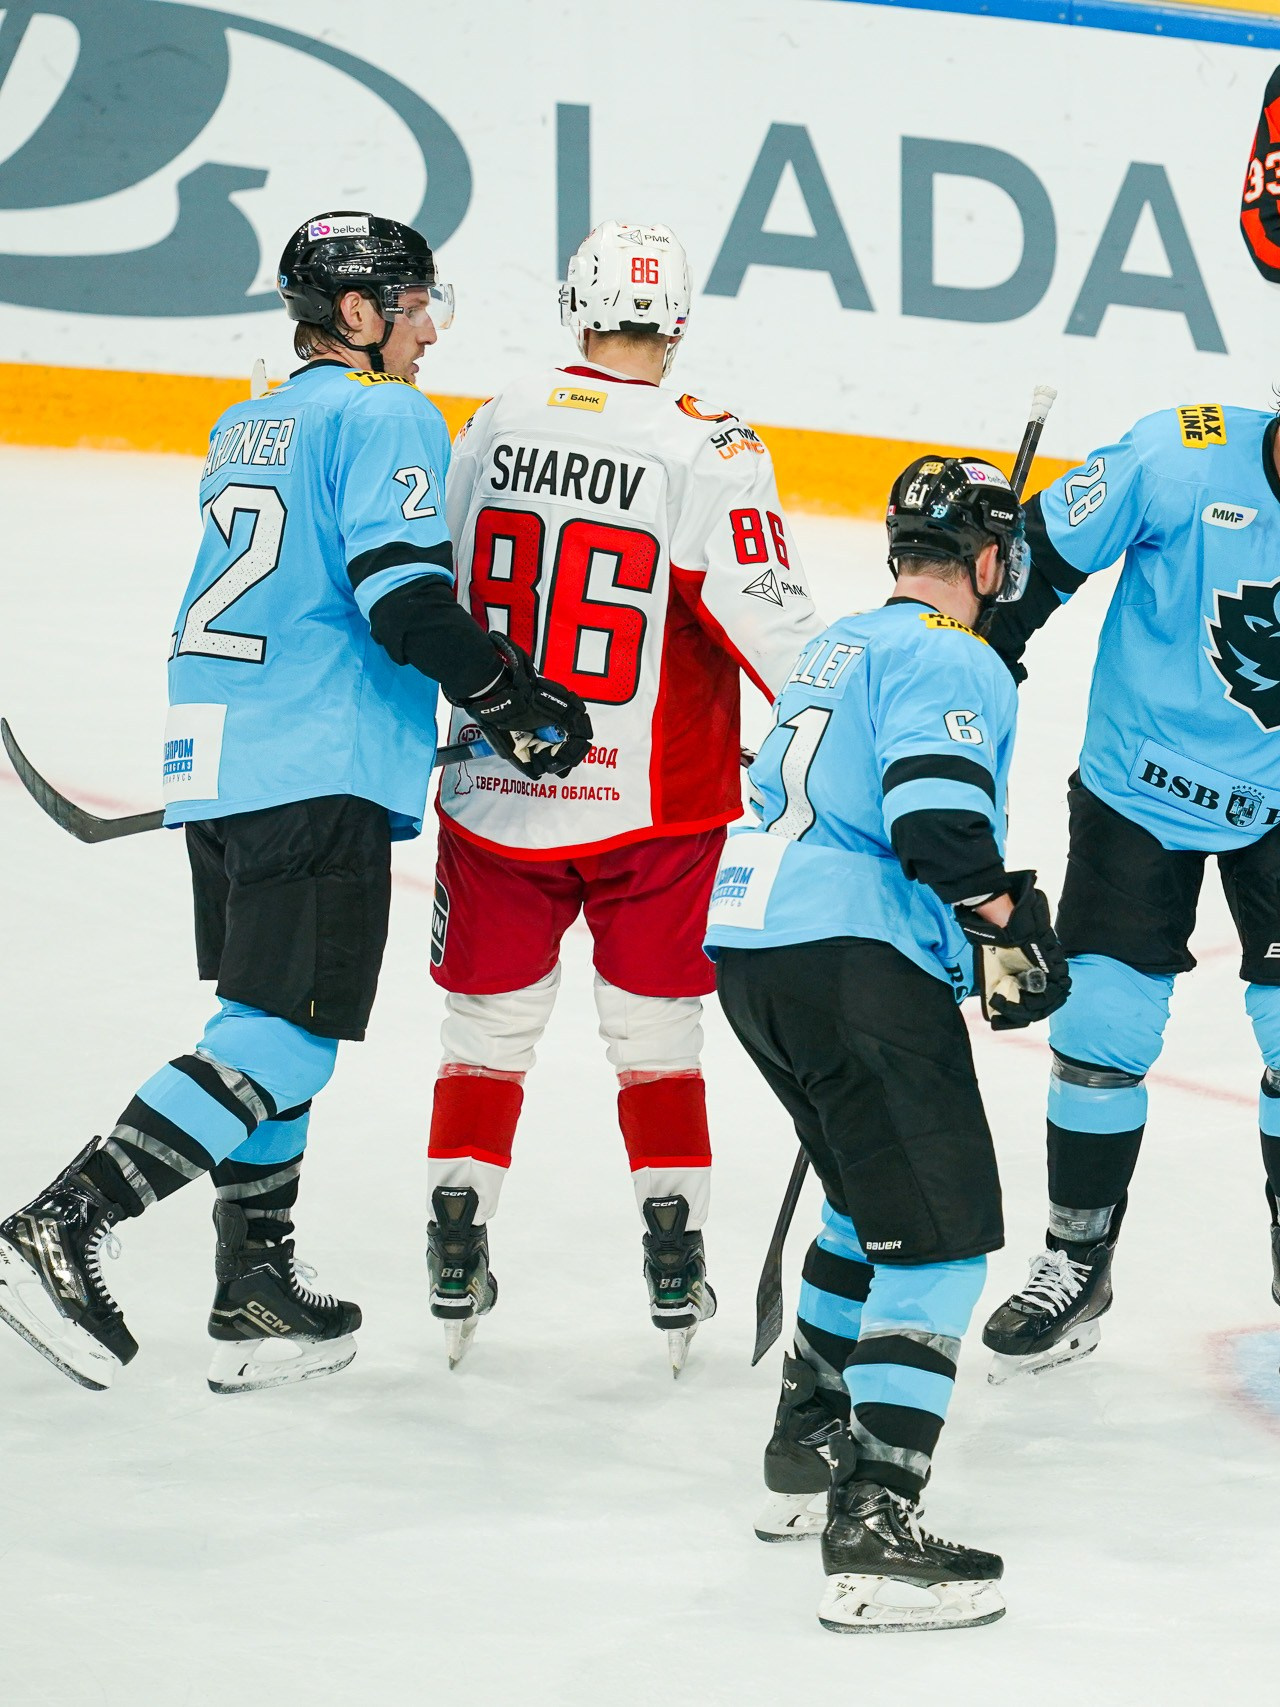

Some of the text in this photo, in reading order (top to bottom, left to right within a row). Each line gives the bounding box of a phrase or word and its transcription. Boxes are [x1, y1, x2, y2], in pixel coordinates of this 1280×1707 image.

[332, 225, 367, 235] belbet
[555, 102, 1229, 355] LADA
[644, 234, 670, 244] РМК
[337, 265, 372, 274] CCM
[631, 257, 659, 284] 86
[570, 393, 600, 405] БАНК
[1180, 409, 1203, 441] LINE
[1200, 406, 1223, 438] MAX
[201, 418, 295, 482] ARDNER
[393, 465, 442, 521] 2
[490, 444, 646, 511] SHAROV
[1064, 456, 1108, 527] 28
[991, 508, 1014, 520] CCM
[1211, 508, 1244, 523] МИР
[729, 508, 790, 570] 86
[167, 482, 288, 665] 2
[469, 506, 661, 706] 86
[943, 709, 994, 763] 6
[581, 746, 618, 769] ВОД
[750, 702, 834, 843] 1
[476, 774, 621, 801] СВЕРДЛОВСКАЯ ОБЛАСТЬ
[1137, 759, 1221, 810] BSB
[652, 1199, 679, 1208] CCM
[246, 1299, 292, 1333] CCM
[836, 1581, 857, 1592] TUK
